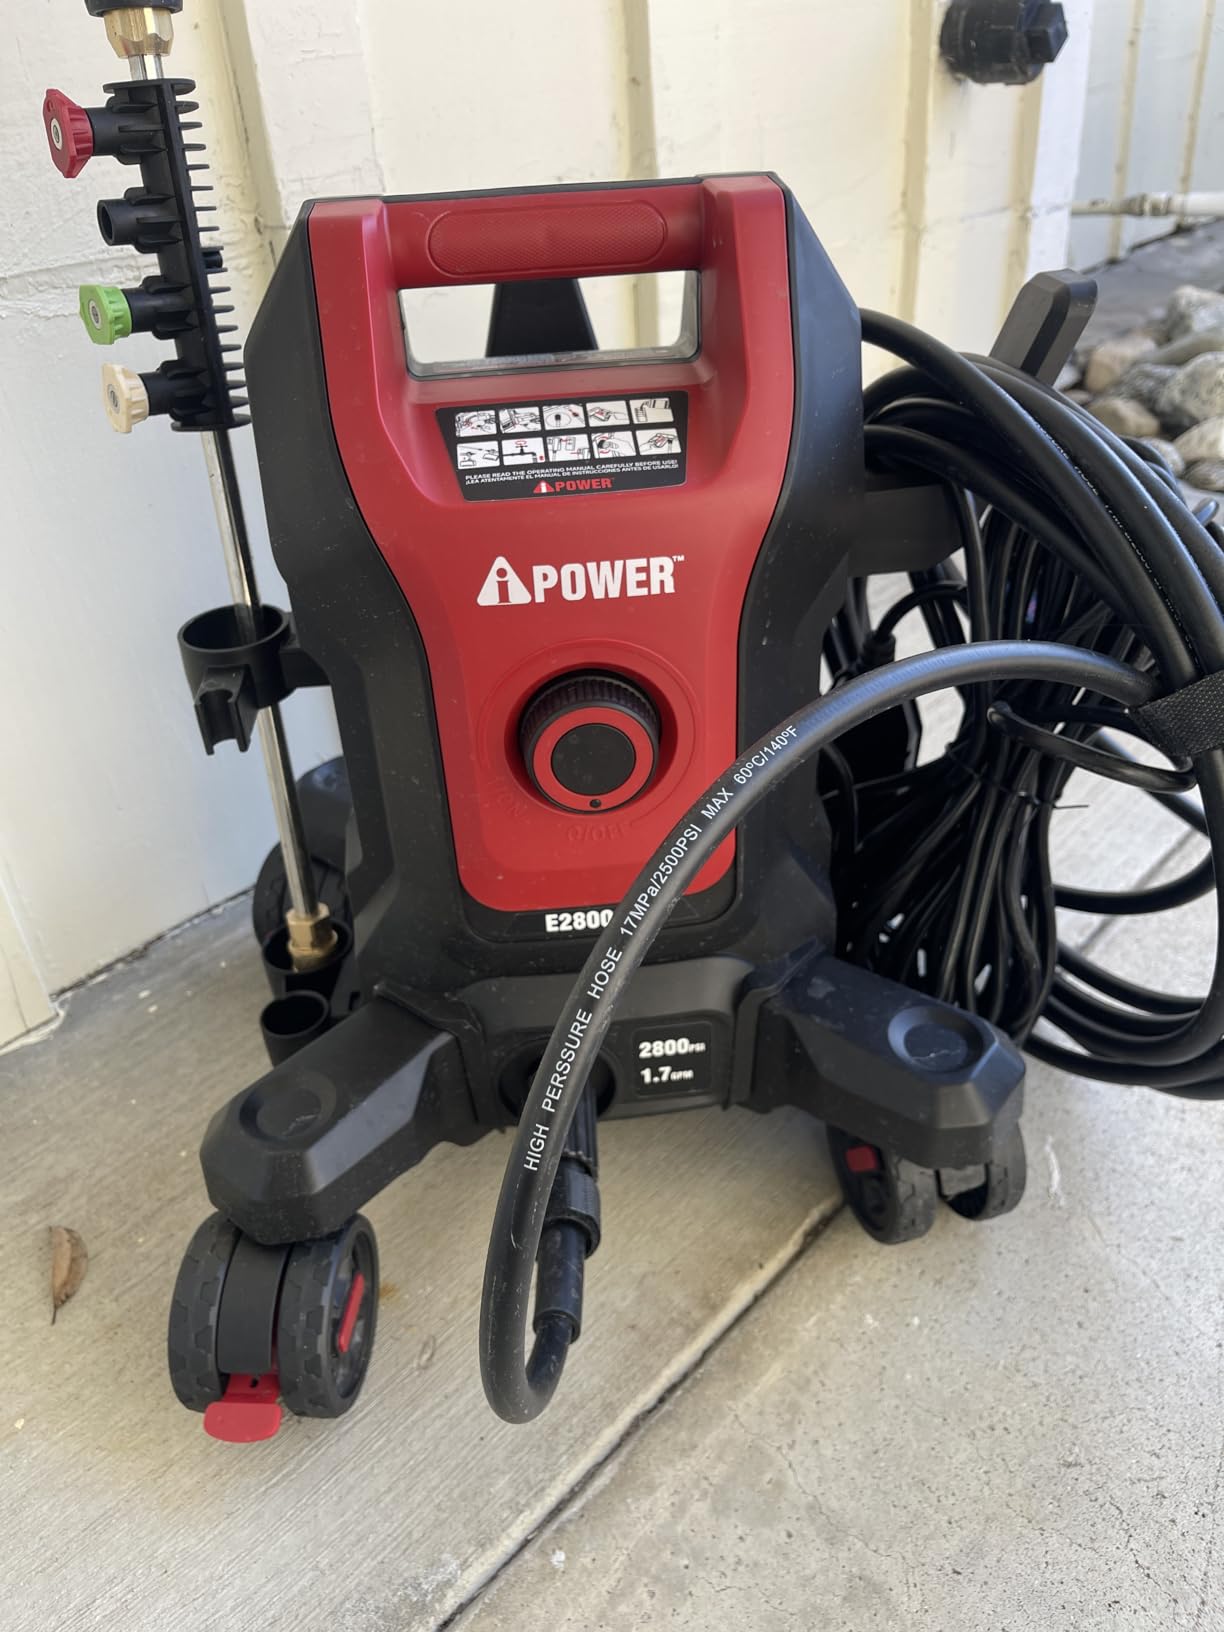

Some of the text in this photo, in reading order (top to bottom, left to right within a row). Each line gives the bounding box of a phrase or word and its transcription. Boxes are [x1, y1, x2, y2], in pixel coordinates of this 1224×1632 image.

[596, 462, 633, 470] CAREFULLY
[480, 475, 525, 483] ATENTAMENTE
[572, 468, 620, 476] INSTRUCCIONES
[523, 1123, 549, 1171] HIGH
[541, 1008, 593, 1112] PERSSURE
[587, 947, 622, 1000] HOSE
[620, 823, 702, 936] 17MPa/2500PSI
[701, 787, 734, 820] MAX
